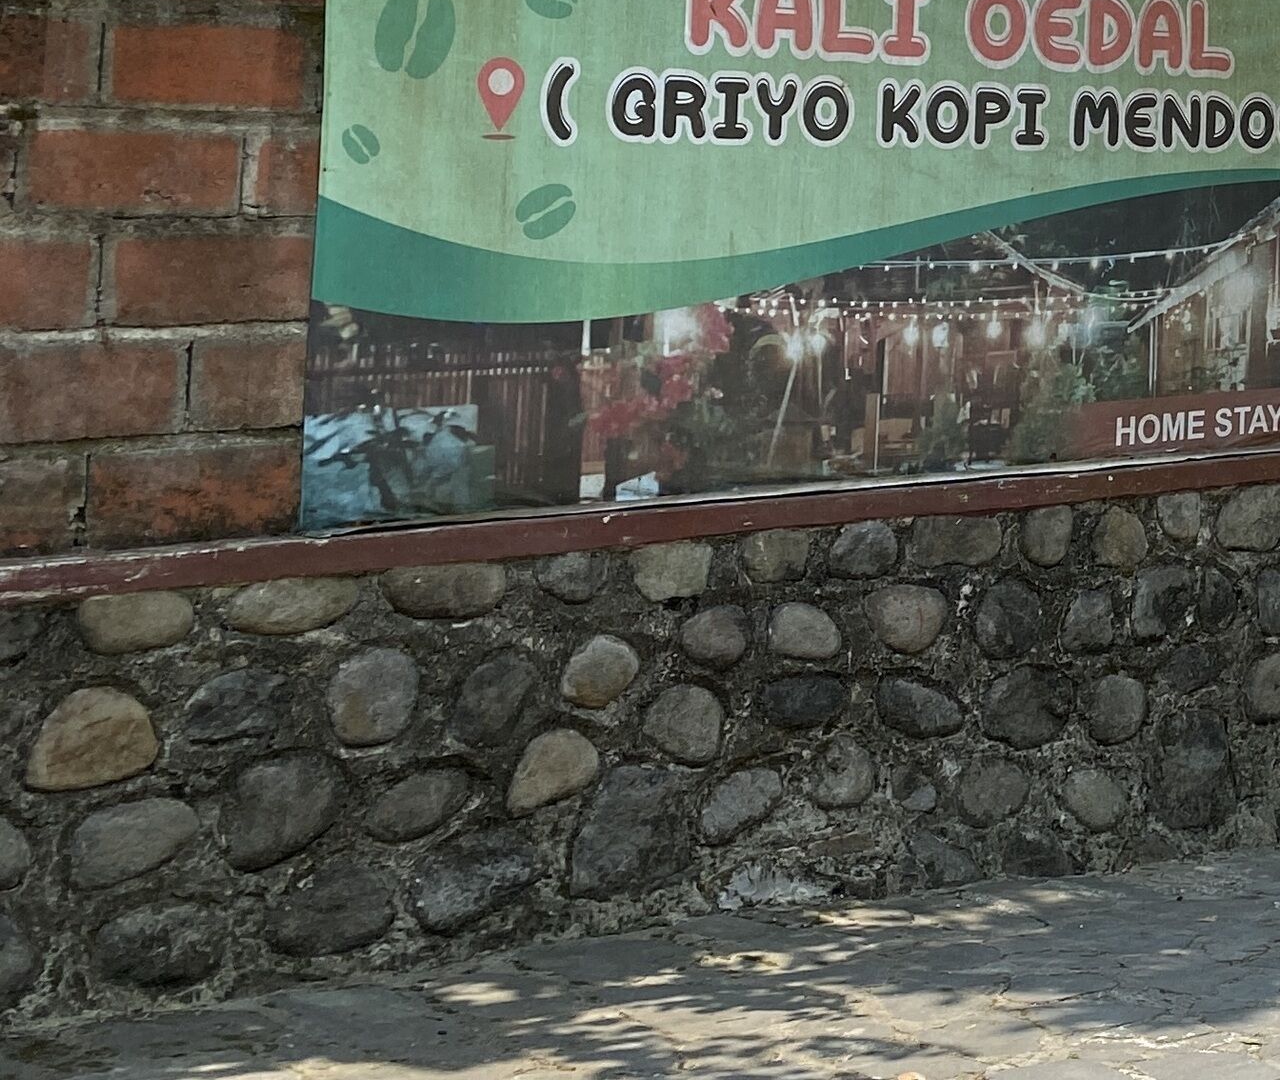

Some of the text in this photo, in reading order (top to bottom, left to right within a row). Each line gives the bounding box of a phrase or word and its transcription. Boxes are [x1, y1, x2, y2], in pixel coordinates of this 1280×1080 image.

[609, 70, 852, 144] GRIYO
[879, 81, 1048, 148] KOPI
[1115, 410, 1206, 447] HOME
